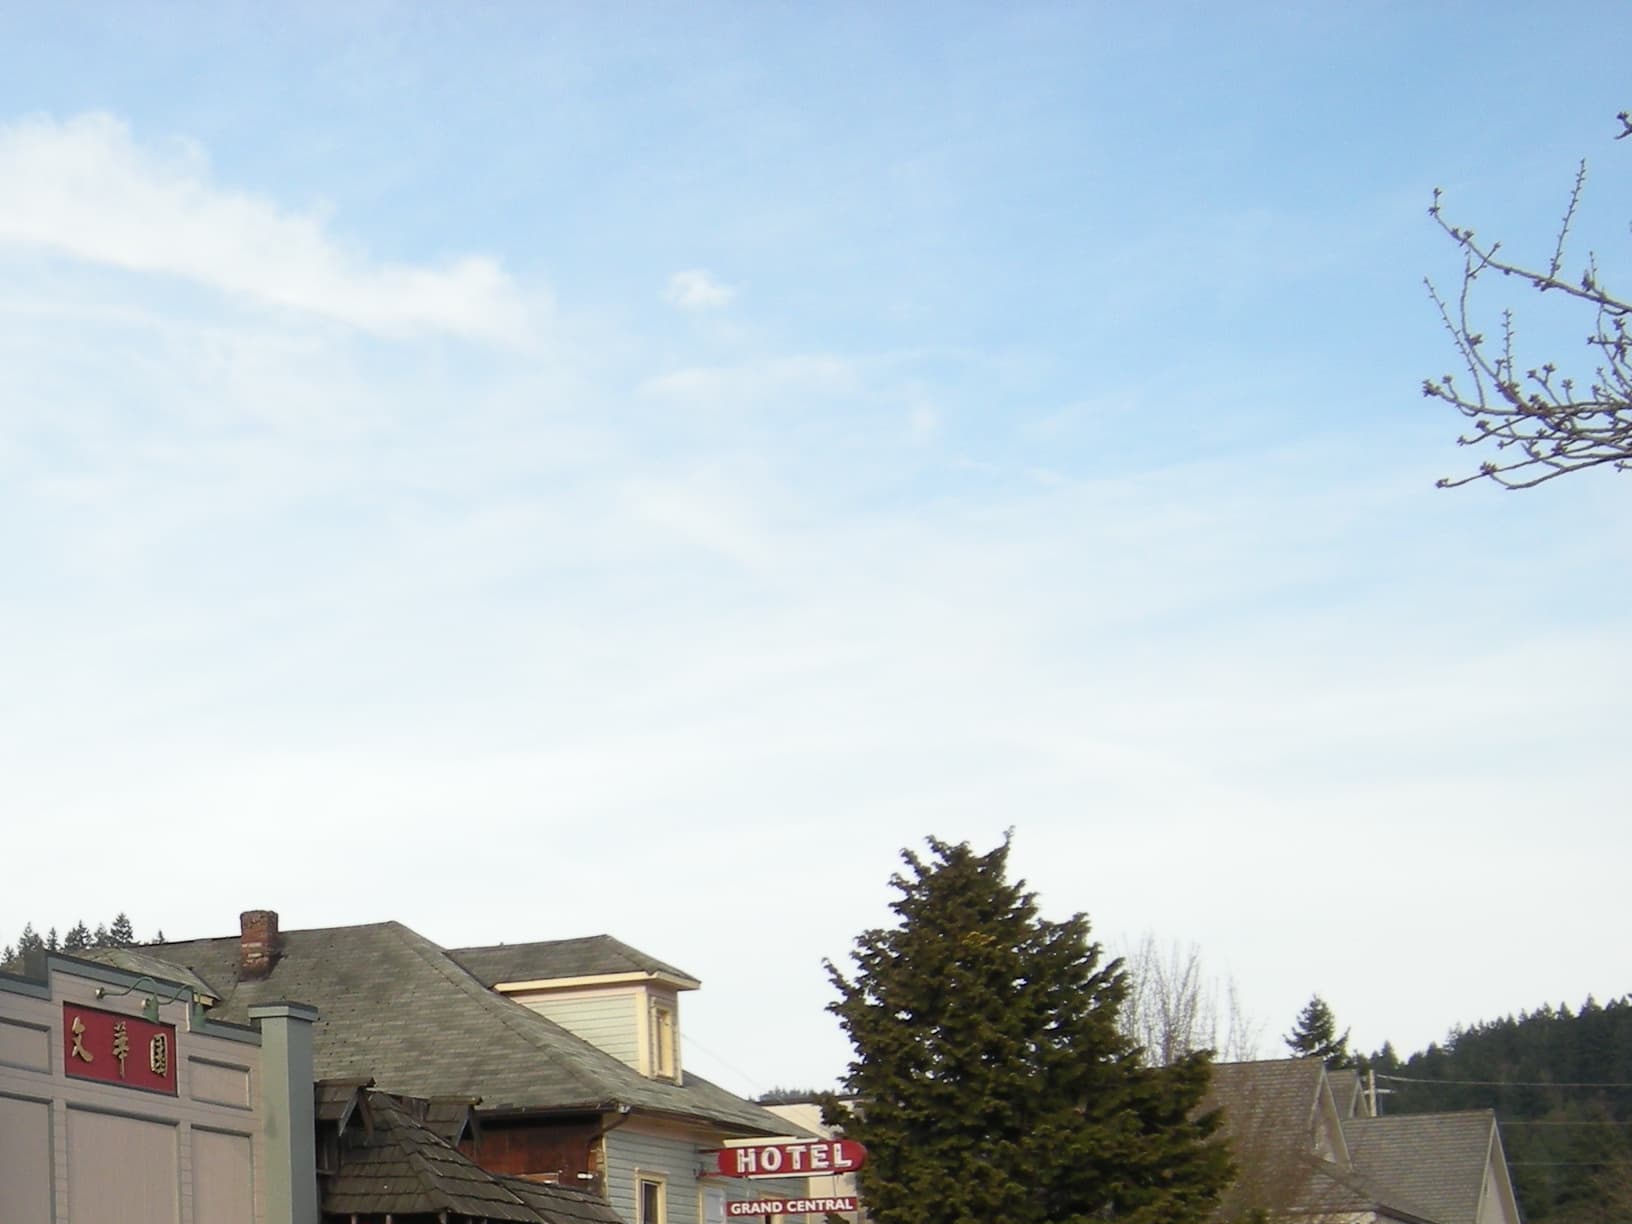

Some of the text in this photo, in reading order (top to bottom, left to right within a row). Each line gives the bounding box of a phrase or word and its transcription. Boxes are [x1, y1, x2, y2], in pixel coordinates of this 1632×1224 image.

[736, 1143, 853, 1173] HOTEL
[730, 1199, 853, 1215] GRAND CENTRAL
